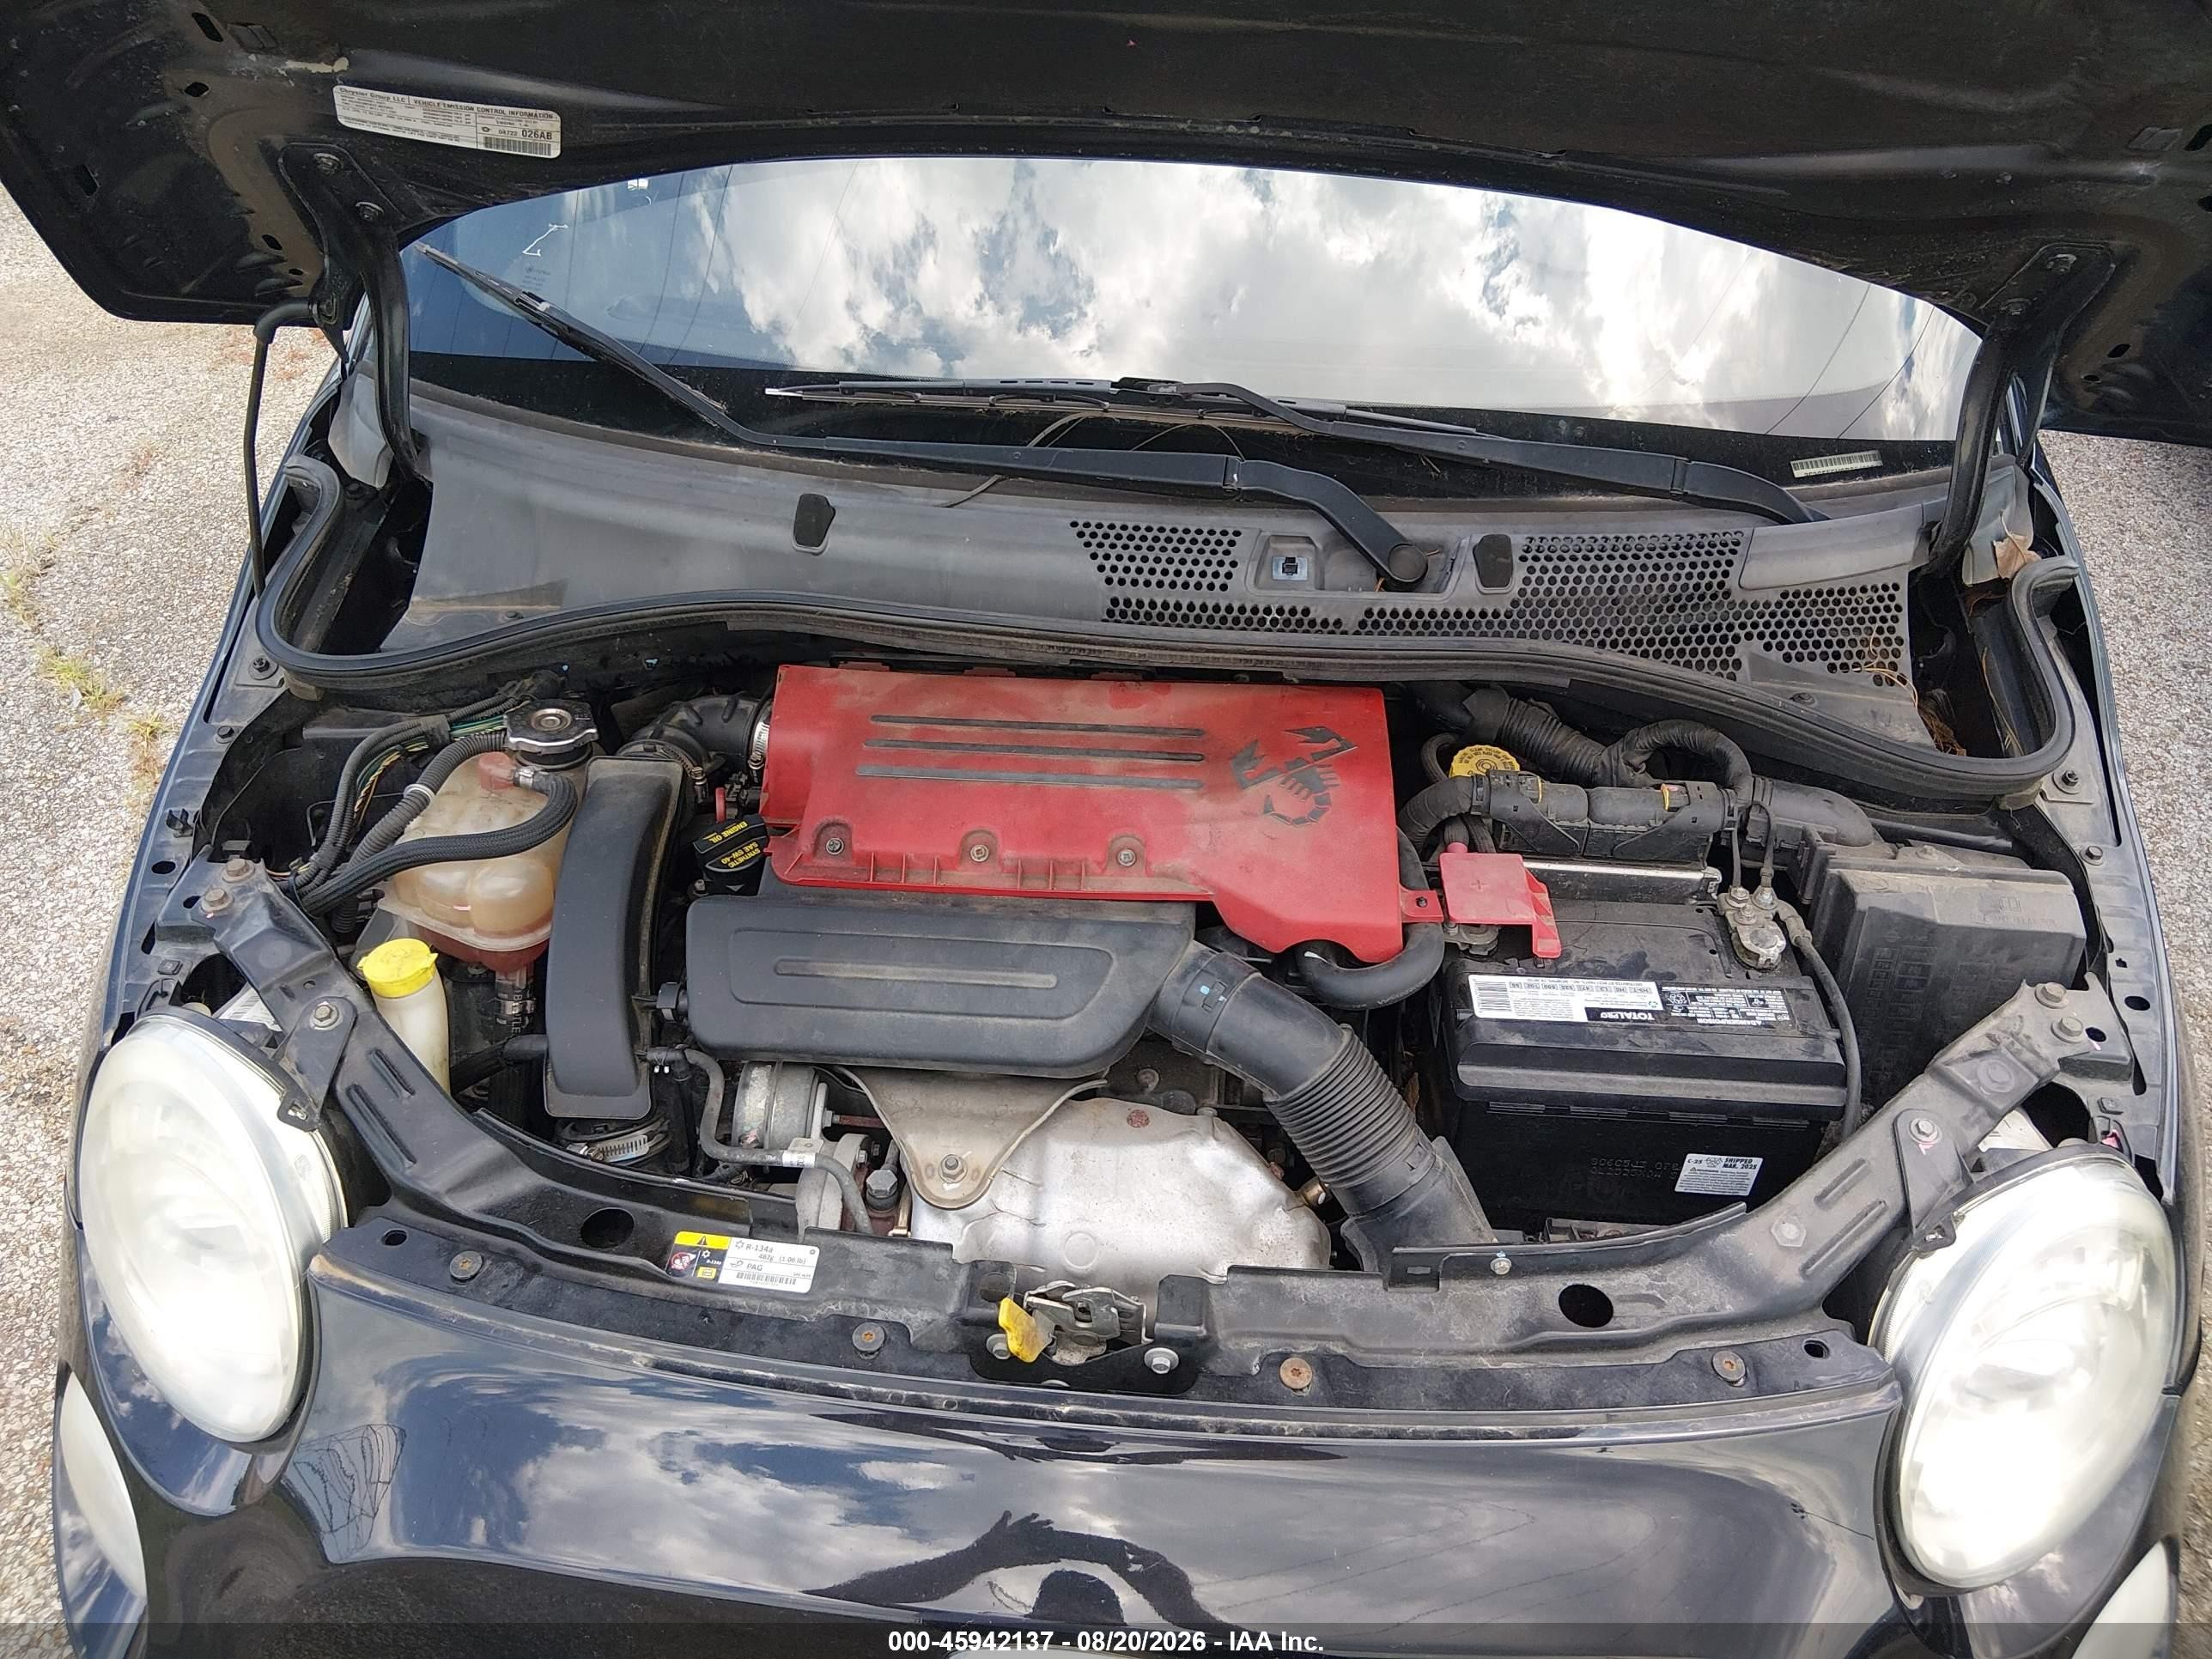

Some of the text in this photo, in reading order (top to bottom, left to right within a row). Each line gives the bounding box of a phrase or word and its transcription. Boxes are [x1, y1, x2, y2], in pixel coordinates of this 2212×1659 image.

[339, 88, 368, 97] Chrysler
[370, 93, 391, 101] Group
[413, 99, 441, 107] VEHICLE
[443, 102, 475, 112] EMISSION
[477, 106, 506, 115] CONTROL
[508, 110, 554, 119] INFORMATION
[521, 129, 553, 140] 026AB
[708, 821, 748, 843] ENGINE OIL
[720, 842, 759, 865] SAE 5W-40
[727, 848, 761, 868] SYNTHETIC
[745, 1243, 774, 1254] R-134a
[746, 1263, 763, 1272] PAG
